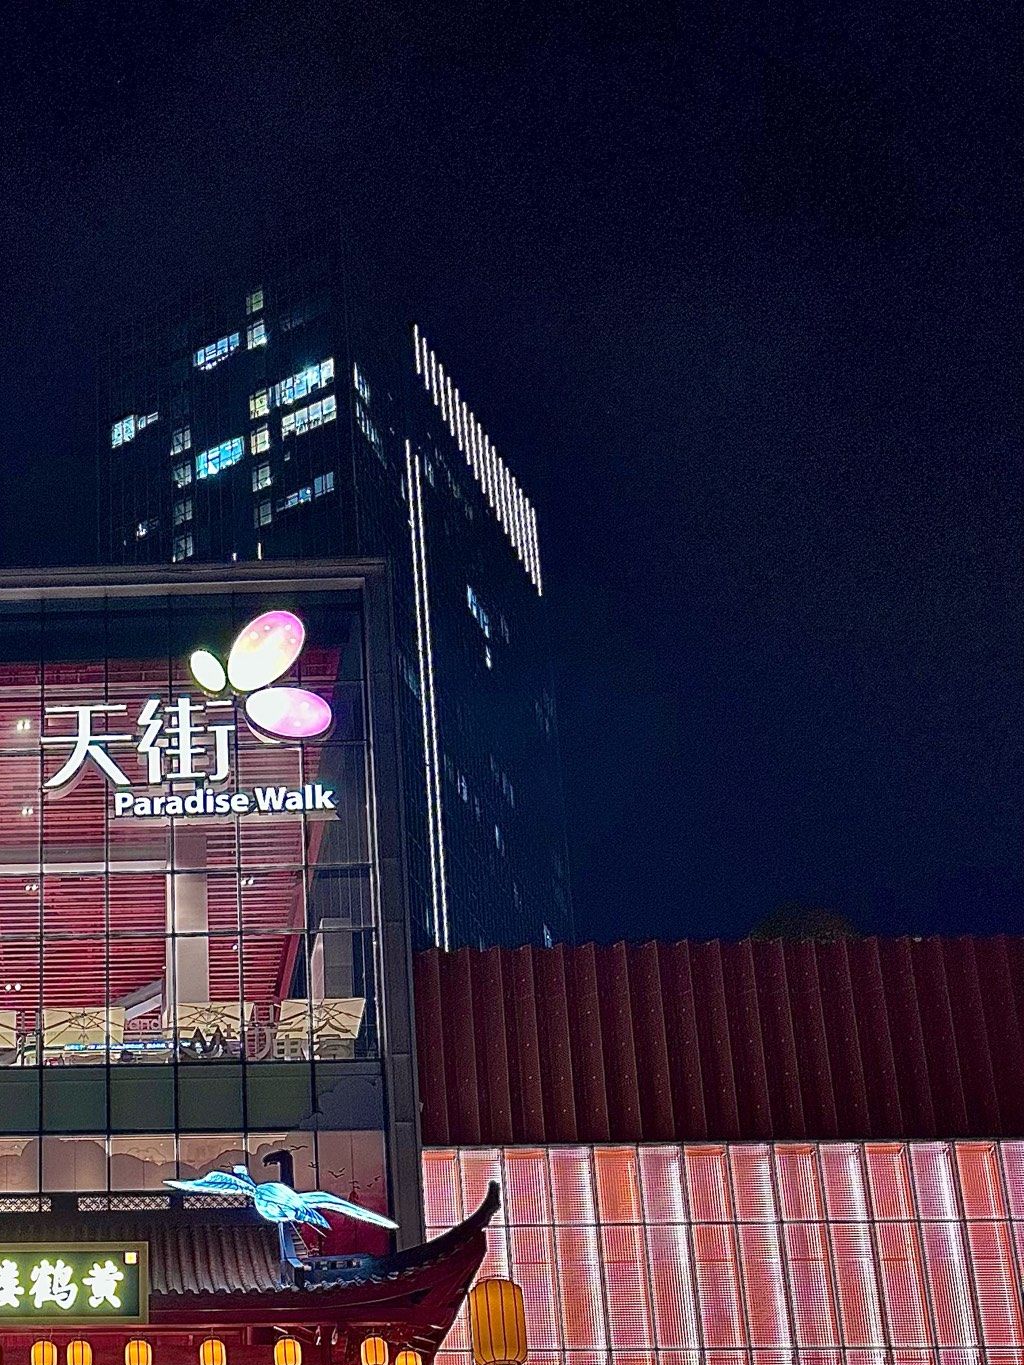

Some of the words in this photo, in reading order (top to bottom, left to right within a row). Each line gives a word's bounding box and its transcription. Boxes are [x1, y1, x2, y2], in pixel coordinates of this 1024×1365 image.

[41, 698, 235, 788] 天街
[114, 787, 250, 817] Paradise
[255, 784, 336, 811] Walk
